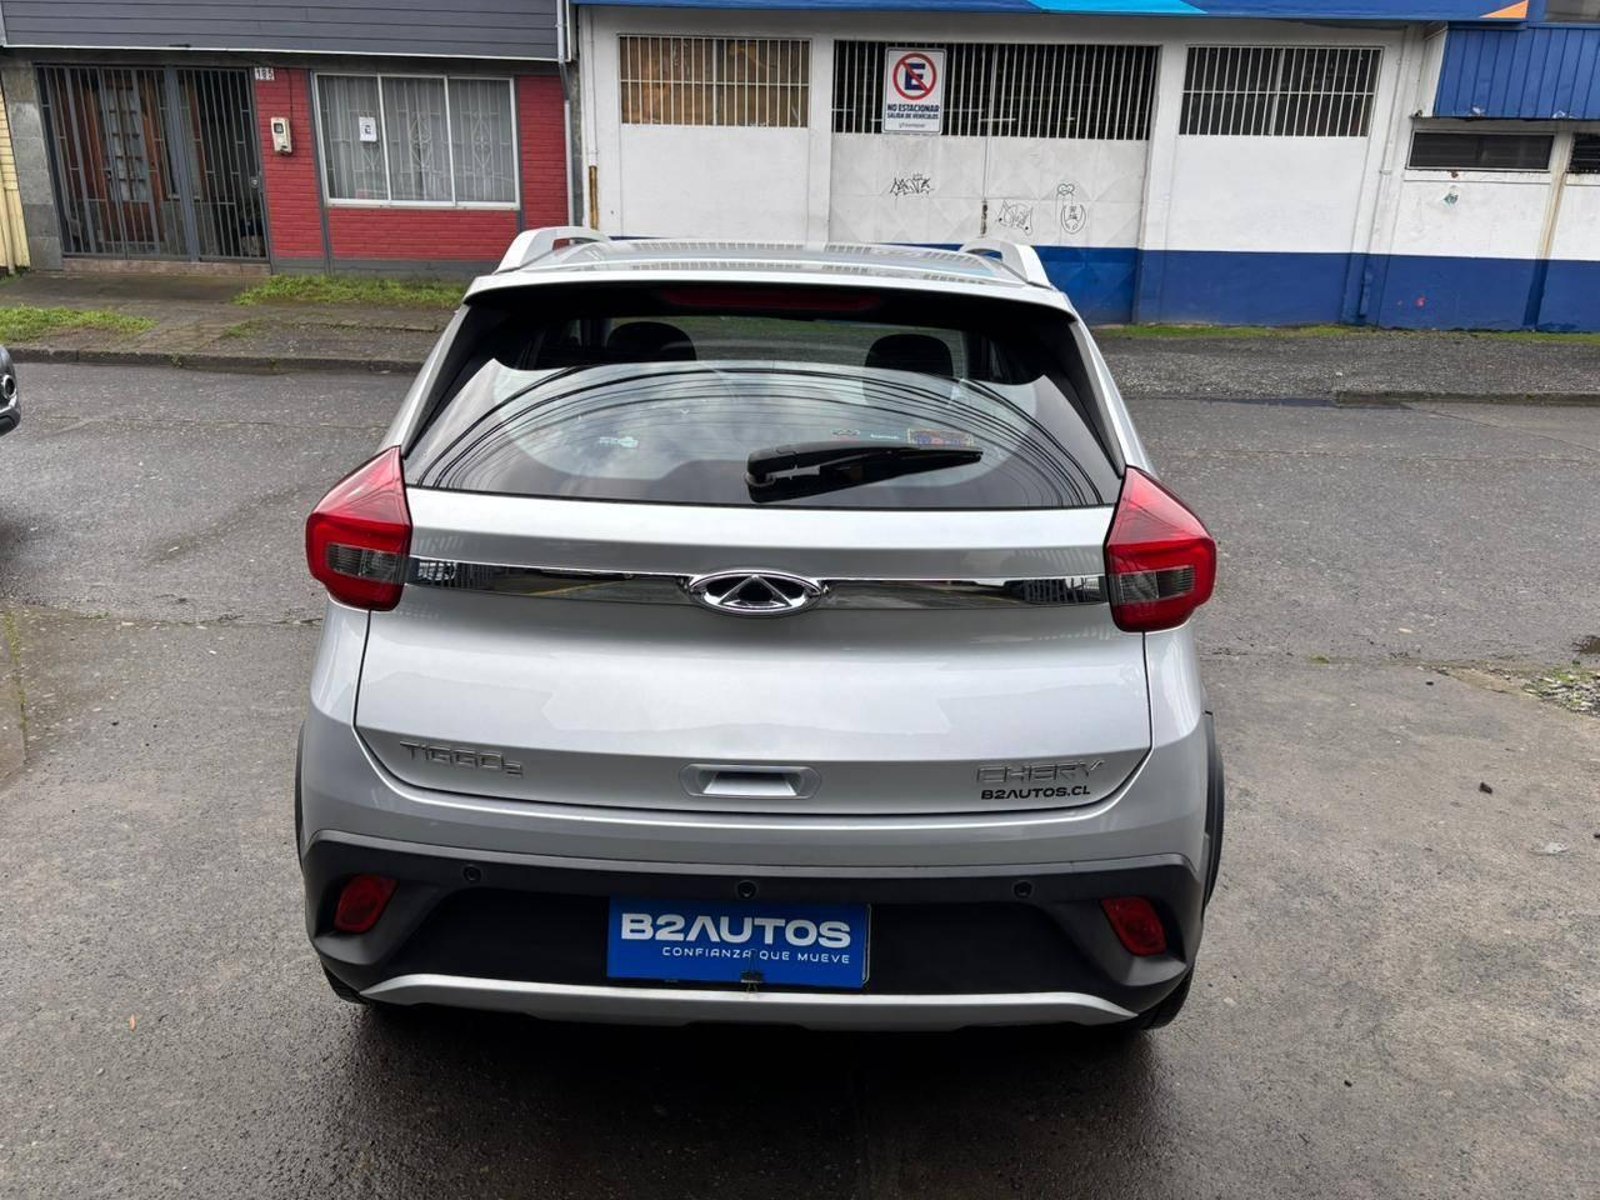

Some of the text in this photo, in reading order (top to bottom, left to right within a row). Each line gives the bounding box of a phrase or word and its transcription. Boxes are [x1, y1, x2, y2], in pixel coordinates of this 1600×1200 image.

[905, 63, 926, 91] E
[887, 104, 940, 112] NO ESTACIONAR
[976, 758, 1105, 783] CHERY
[981, 785, 1091, 801] B2AUTOS.CL
[621, 912, 851, 949] B2AUTOS
[662, 946, 850, 964] CONFIANZA QUE MUEVE
